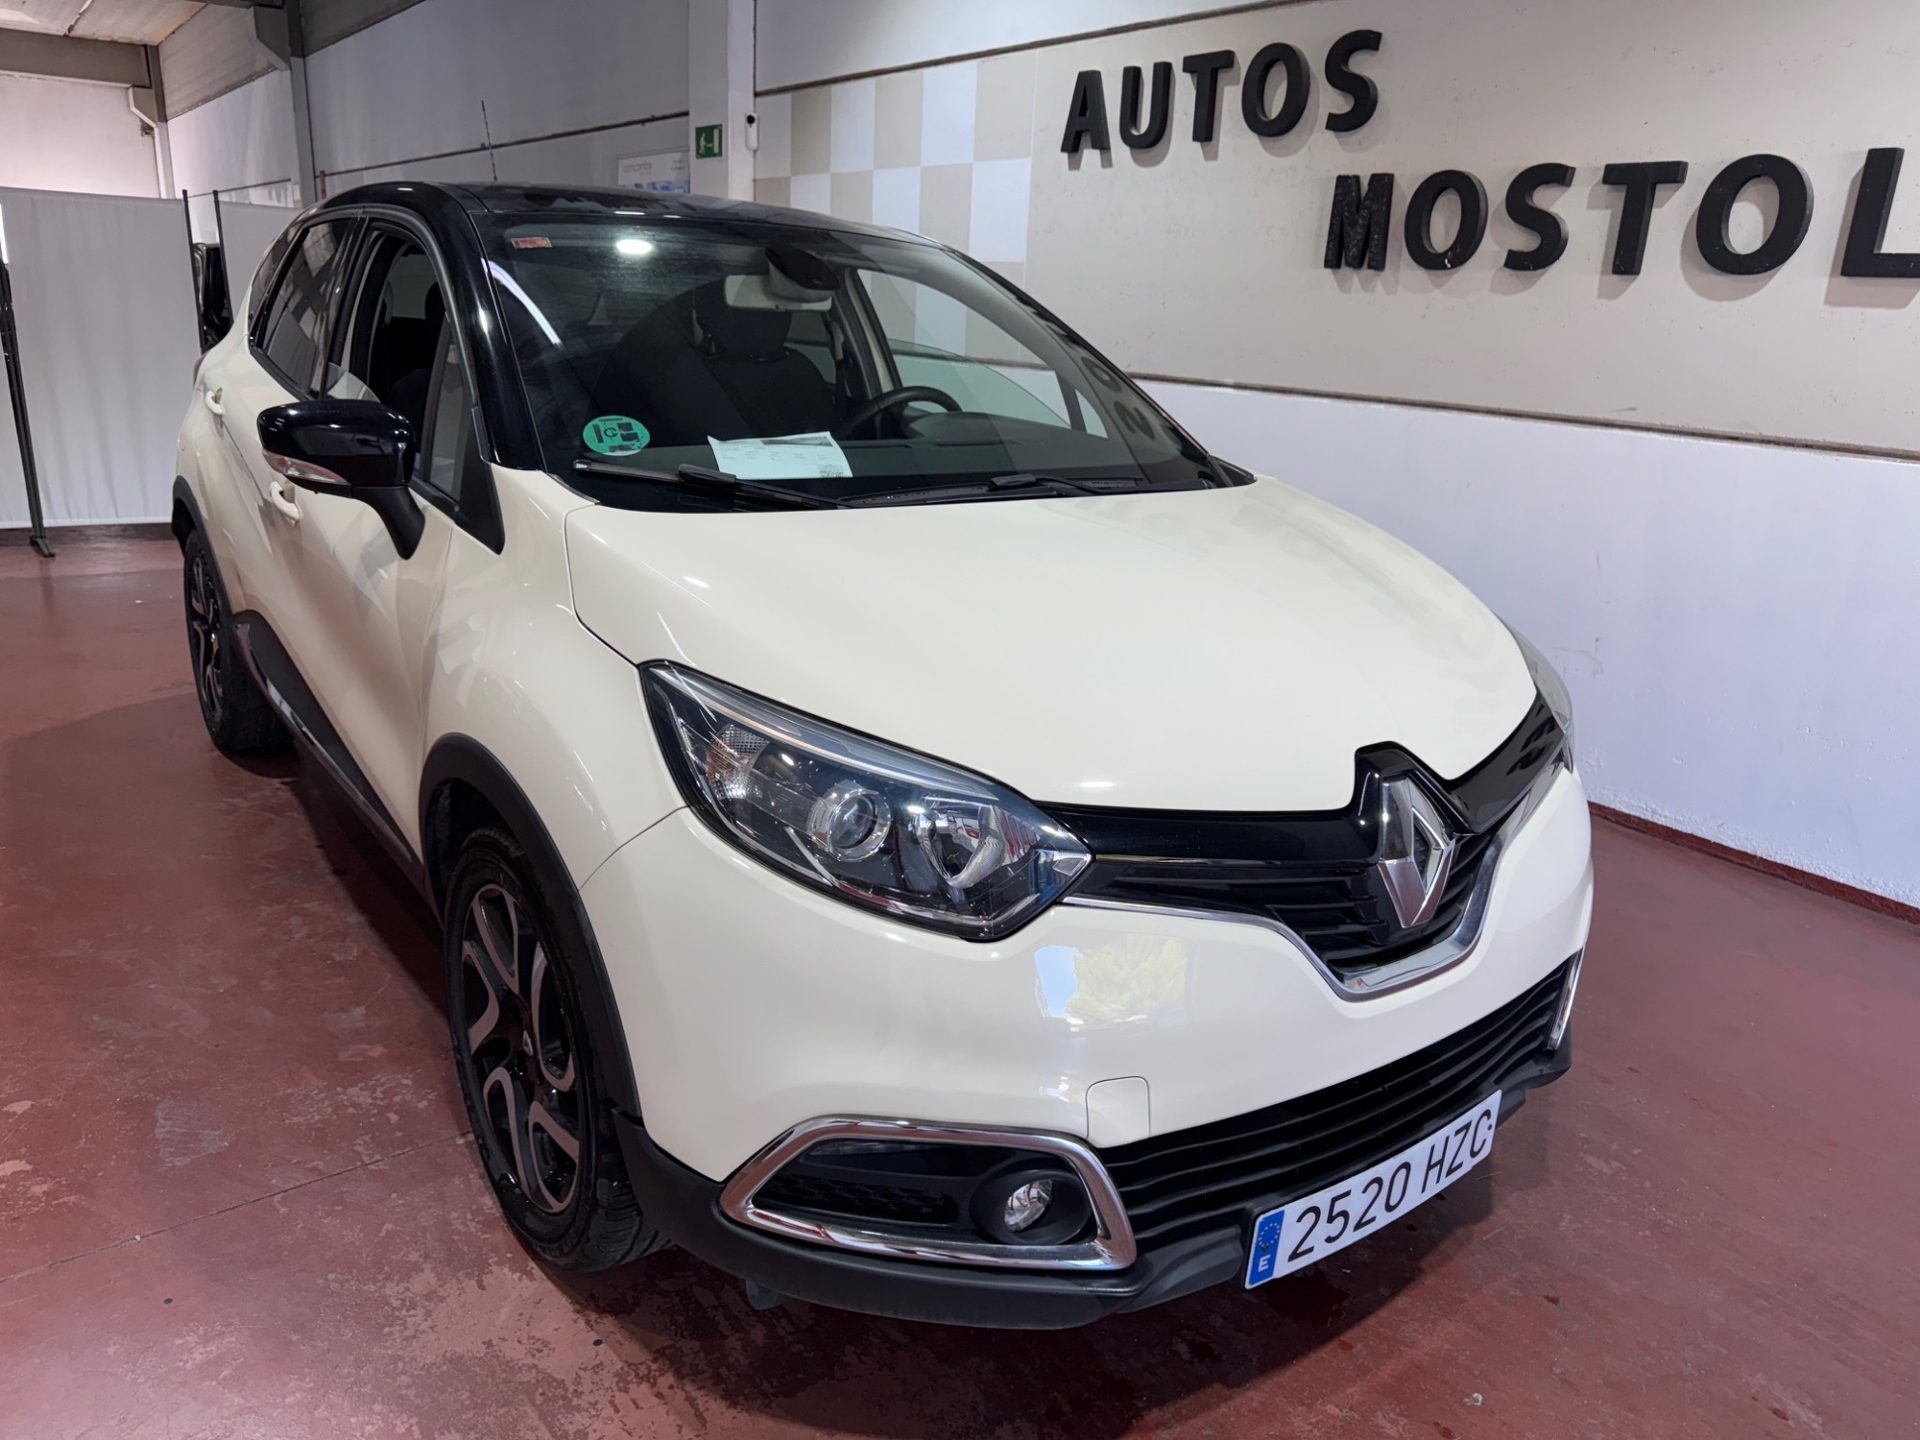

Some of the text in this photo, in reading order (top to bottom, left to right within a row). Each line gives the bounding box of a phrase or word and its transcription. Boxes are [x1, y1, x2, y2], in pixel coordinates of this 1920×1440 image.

[1060, 29, 1383, 154] AUTOS
[1323, 147, 1920, 278] MOSTOL
[1287, 1109, 1492, 1262] 2520 HZC
[1257, 1254, 1271, 1273] E
